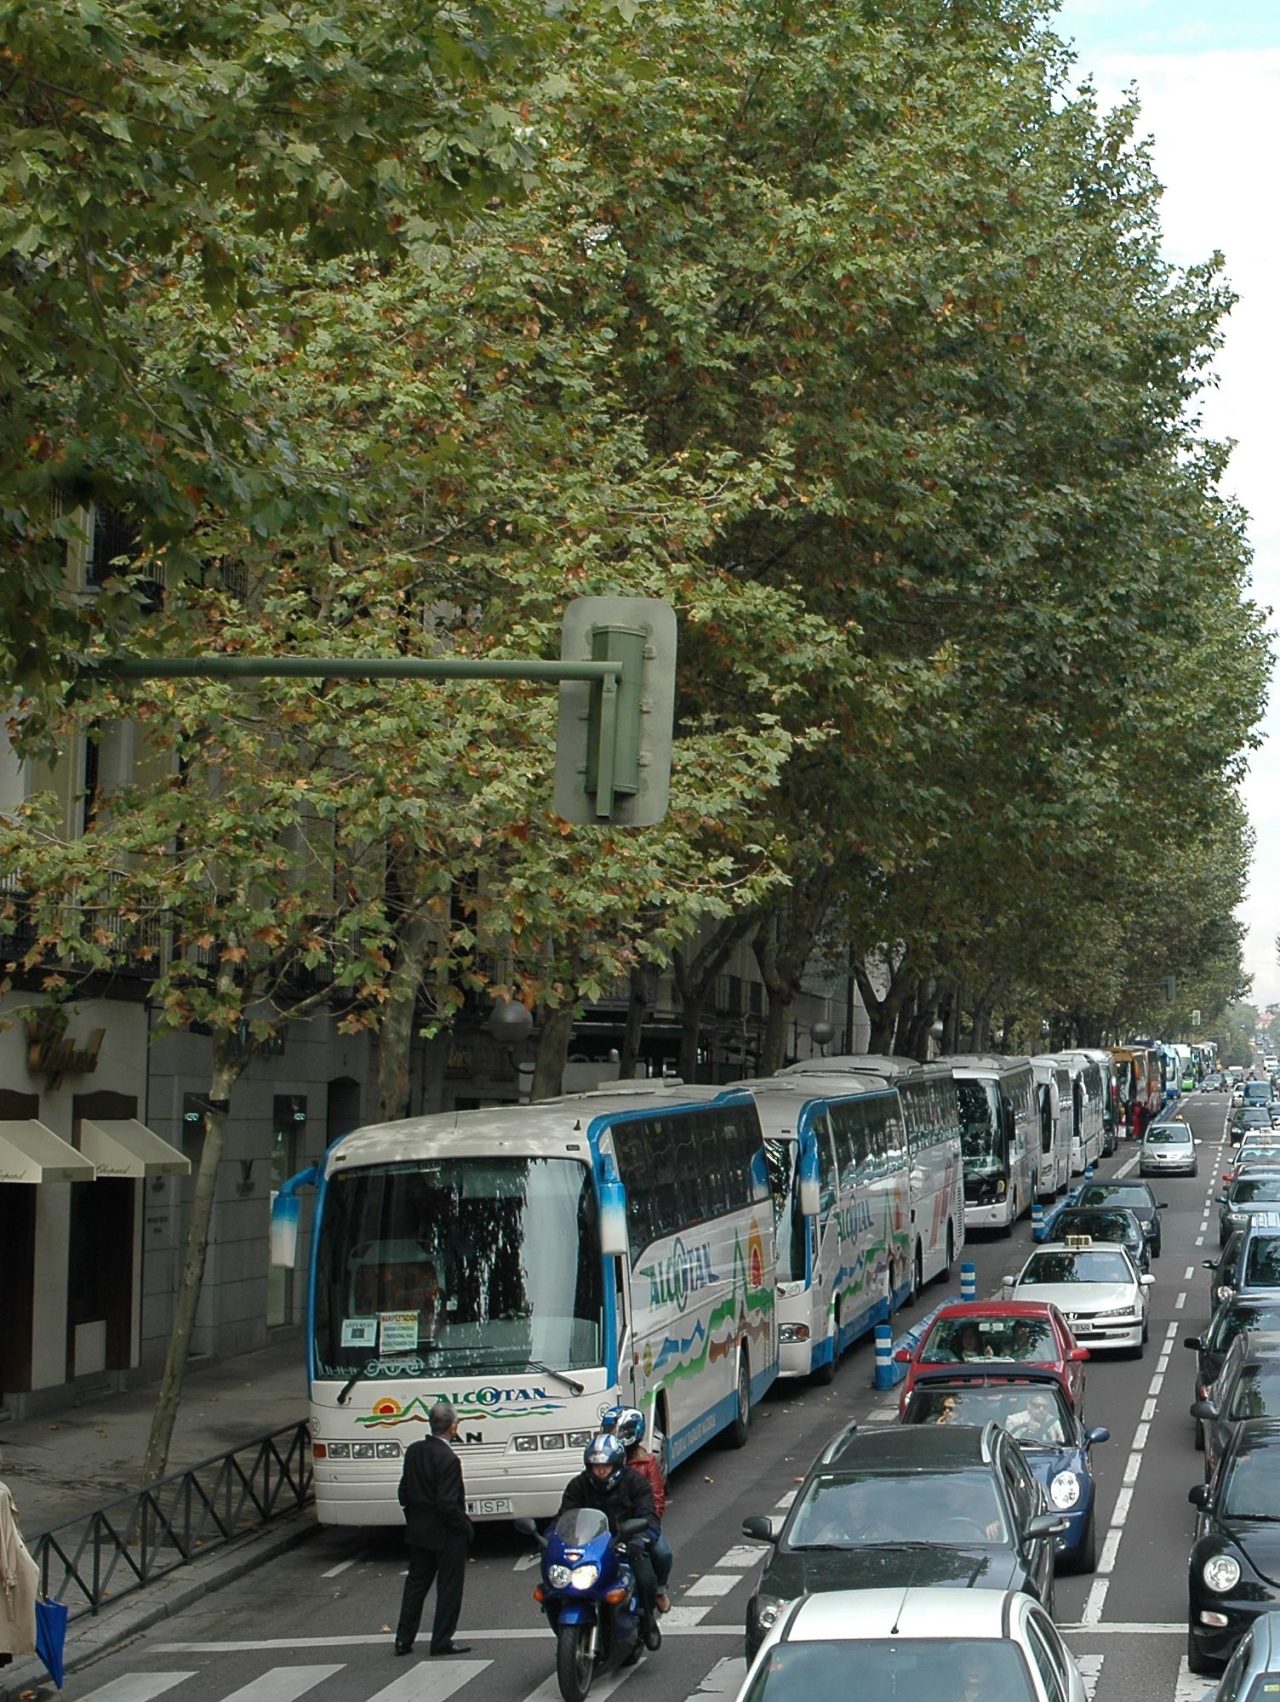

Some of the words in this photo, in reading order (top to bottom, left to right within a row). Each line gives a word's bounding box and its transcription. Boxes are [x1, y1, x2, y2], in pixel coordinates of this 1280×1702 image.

[640, 1237, 720, 1313] ALCOTAN
[423, 1386, 557, 1406] ALCOTAN
[483, 1500, 506, 1513] SP
